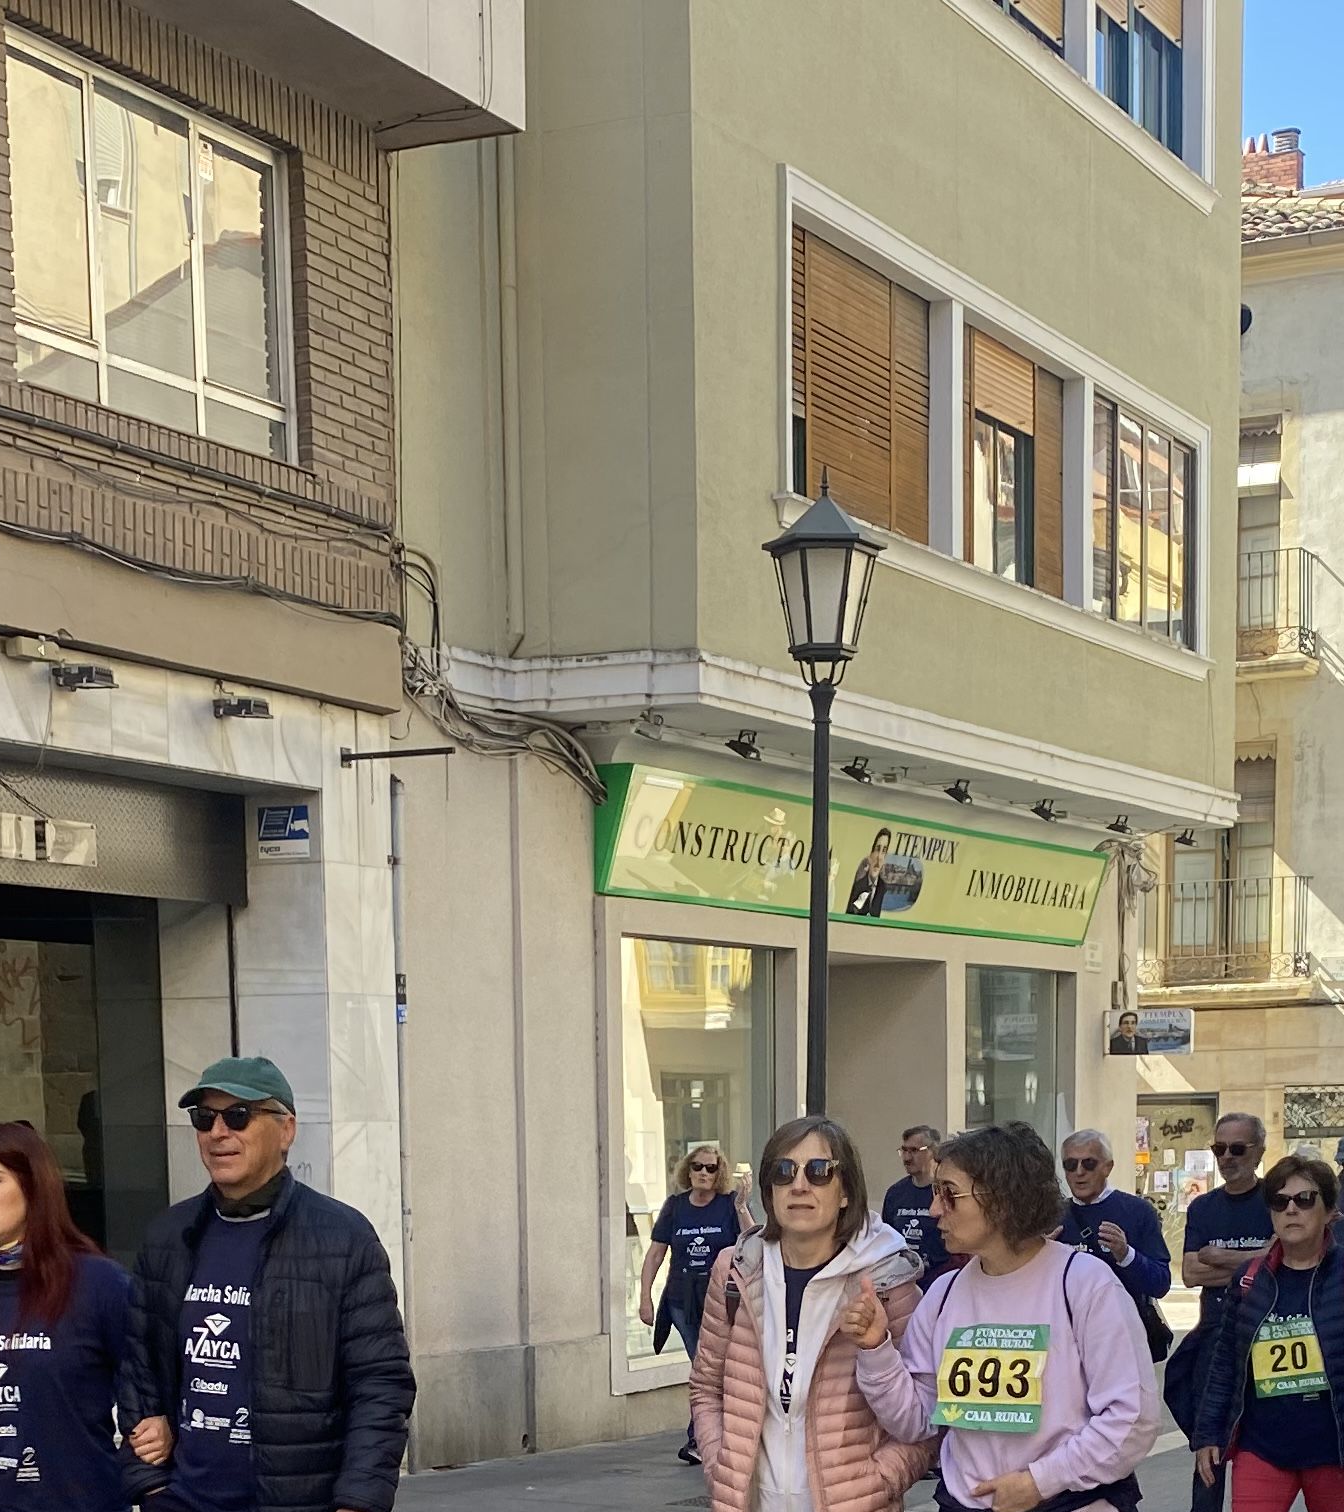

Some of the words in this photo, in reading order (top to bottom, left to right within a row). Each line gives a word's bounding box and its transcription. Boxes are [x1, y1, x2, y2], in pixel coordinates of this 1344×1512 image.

[634, 815, 832, 872] CONSTRUCTO
[894, 832, 959, 864] TTEMPUX
[966, 869, 1087, 910] INMOBILIARIA
[185, 1327, 241, 1368] AZAYCA
[975, 1328, 1036, 1339] FUNDACION
[975, 1339, 997, 1347] CAJA
[1000, 1340, 1033, 1348] RURAL
[1270, 1341, 1308, 1372] 20
[949, 1357, 1030, 1398] 693
[964, 1411, 991, 1421] CAJA
[994, 1412, 1033, 1423] RURAL
